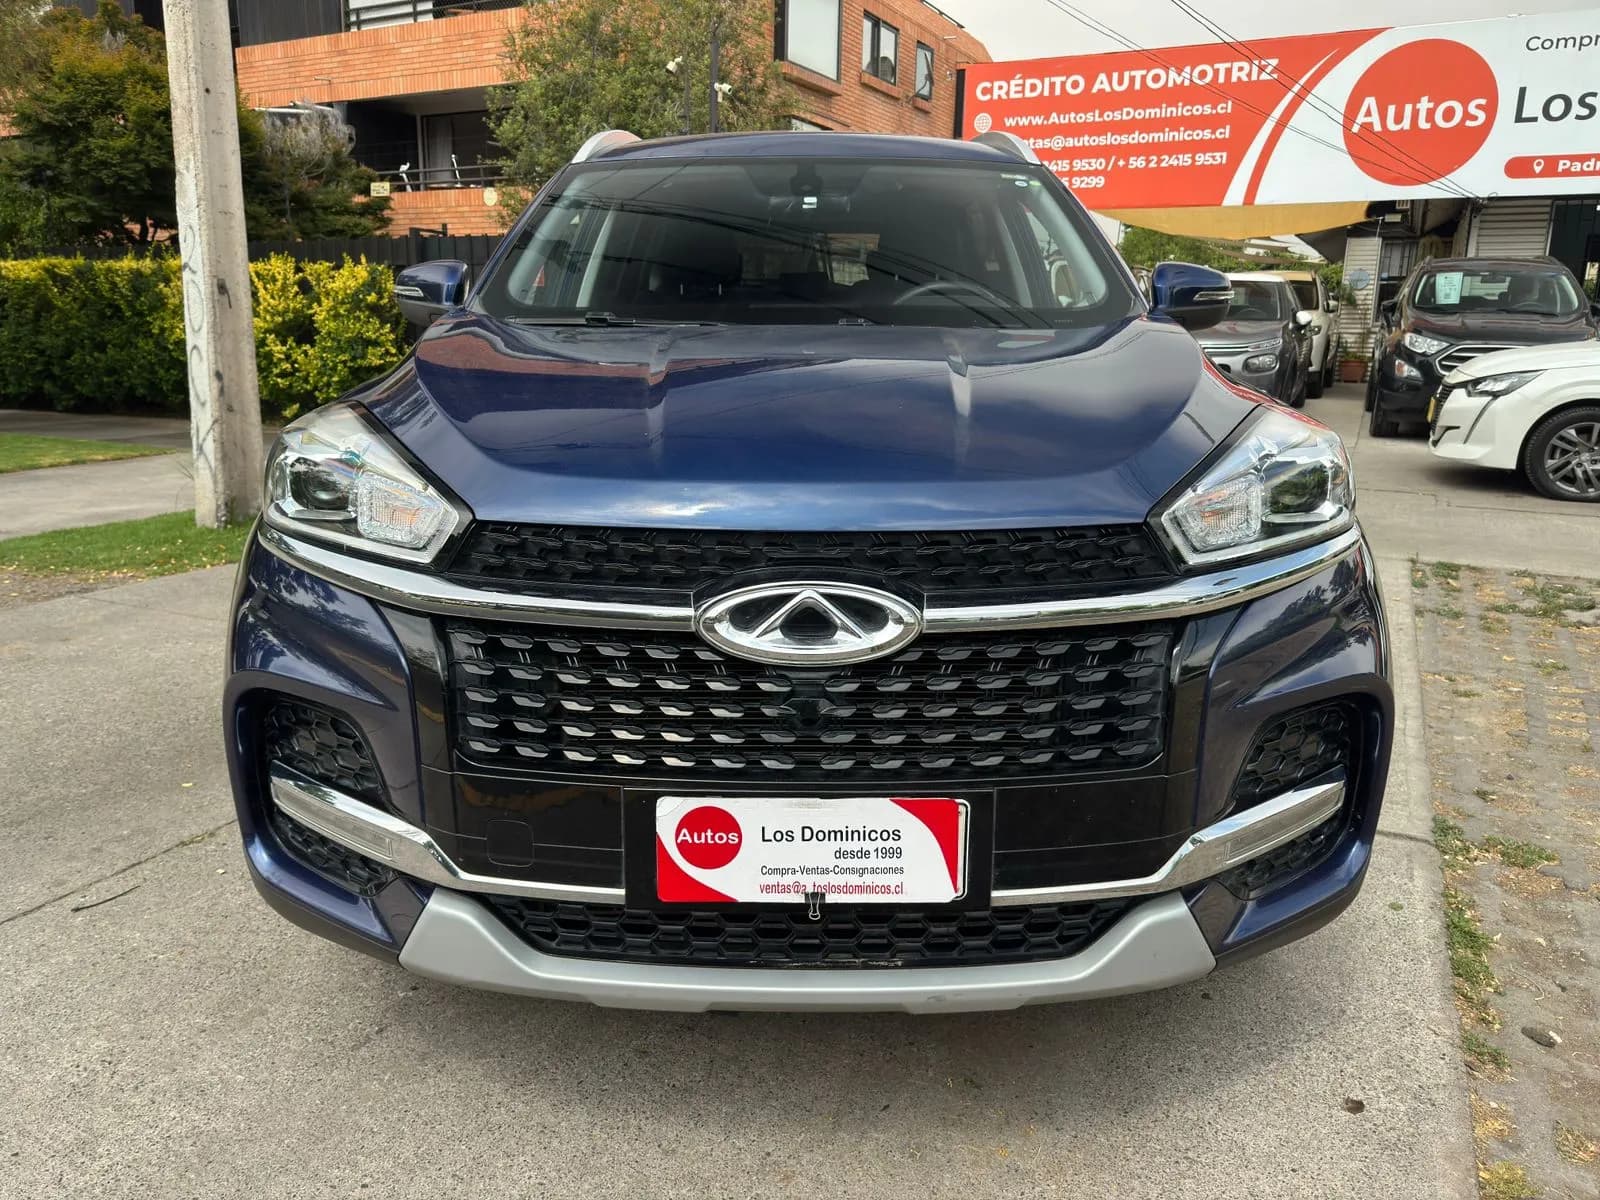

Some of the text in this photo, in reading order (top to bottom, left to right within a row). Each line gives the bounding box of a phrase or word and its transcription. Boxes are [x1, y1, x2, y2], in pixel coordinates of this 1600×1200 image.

[975, 58, 1279, 101] CRÉDITO AUTOMOTRIZ
[1004, 101, 1232, 128] www.AutosLosDominicos.cl
[1350, 95, 1488, 134] Autos
[1514, 86, 1598, 124] Los
[1072, 157, 1106, 171] 9530
[1128, 155, 1146, 169] 56
[1149, 154, 1158, 168] 2
[1160, 153, 1192, 168] 2415
[1195, 151, 1227, 166] 9531
[1072, 176, 1105, 188] 9299
[677, 828, 739, 844] Autos
[761, 825, 902, 843] Los Dominicos
[834, 846, 903, 859] desde 1999
[760, 865, 905, 878] Compra-Ventas-Consignaciones
